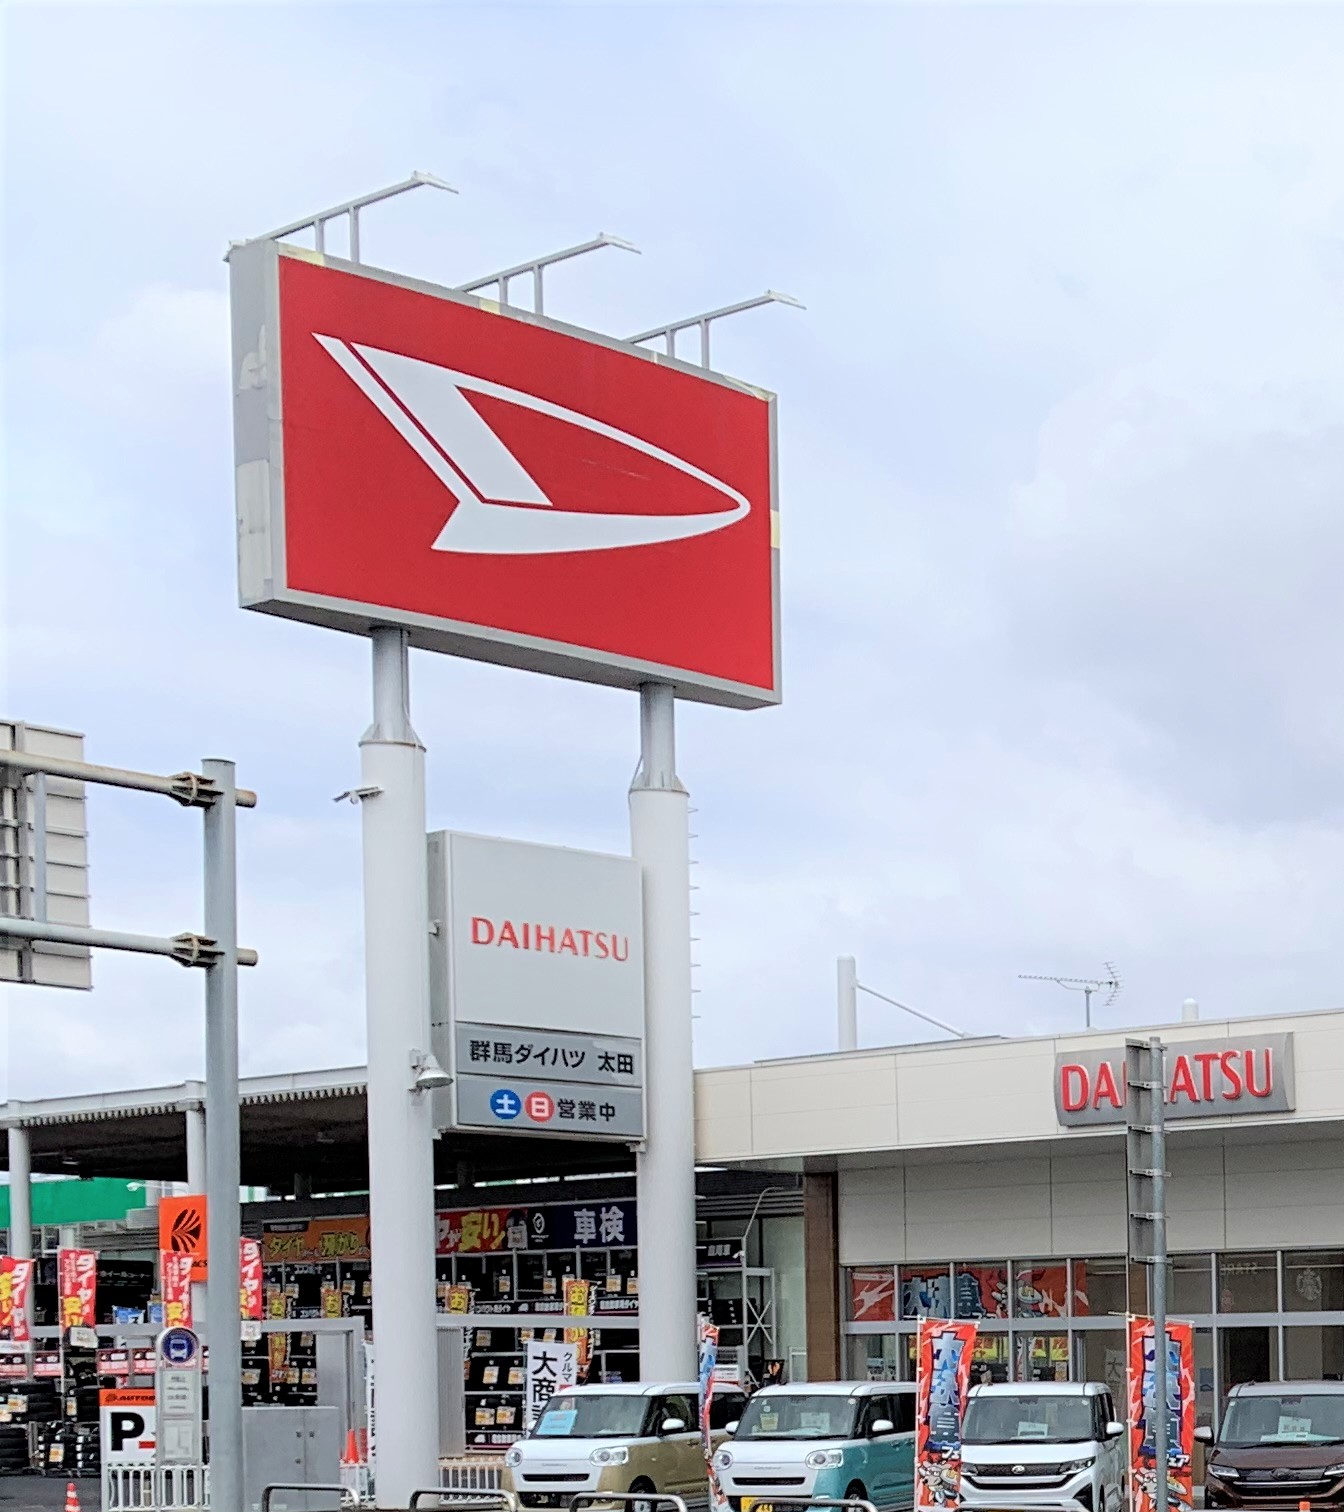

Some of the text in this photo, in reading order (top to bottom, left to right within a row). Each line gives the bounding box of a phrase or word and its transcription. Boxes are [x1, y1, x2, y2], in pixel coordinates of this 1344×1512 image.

[471, 916, 629, 962] DAIHATSU
[469, 1039, 634, 1075] 群馬ダイハツ 太田
[573, 1206, 625, 1244] 車検
[242, 1242, 260, 1307] タイヤが
[561, 1352, 573, 1382] クルマ
[110, 1411, 145, 1451] P
